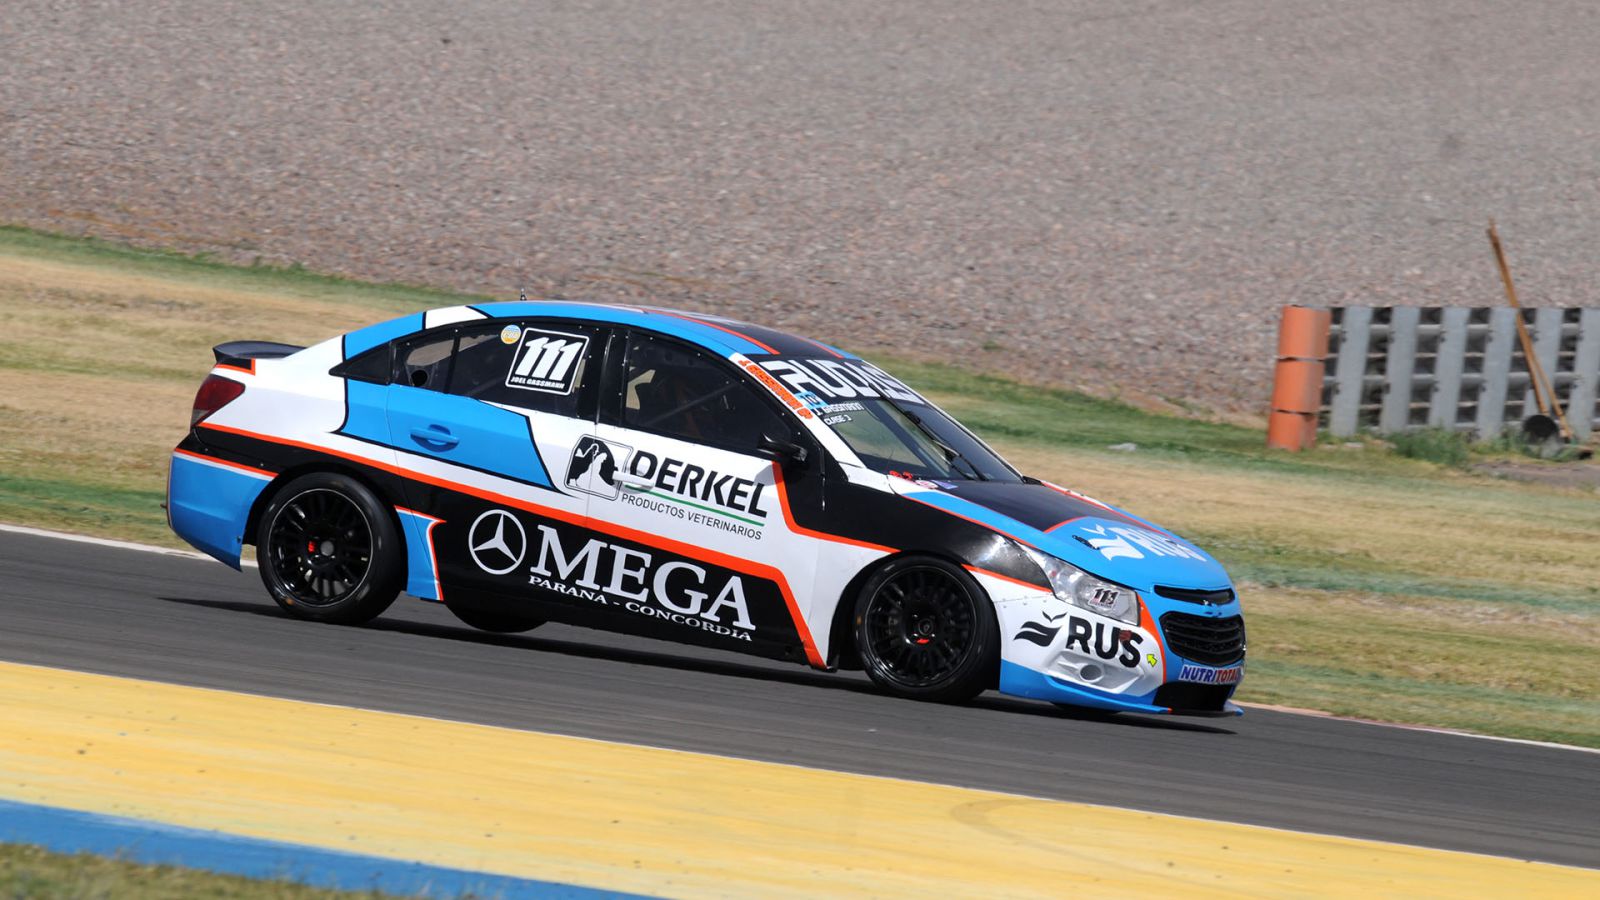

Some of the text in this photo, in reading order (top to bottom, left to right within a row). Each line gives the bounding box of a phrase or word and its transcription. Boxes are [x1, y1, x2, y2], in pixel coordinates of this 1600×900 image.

[510, 376, 565, 389] JOEL GASSMANN
[515, 337, 583, 381] 111
[759, 359, 926, 405] RUDAS
[629, 449, 767, 518] DERKEL
[621, 494, 762, 541] PRODUCTOS VETERINARIOS
[530, 524, 756, 631] MEGA
[528, 576, 608, 605] PARANA
[625, 601, 753, 642] CONCORDIA
[1065, 615, 1144, 669] RUS
